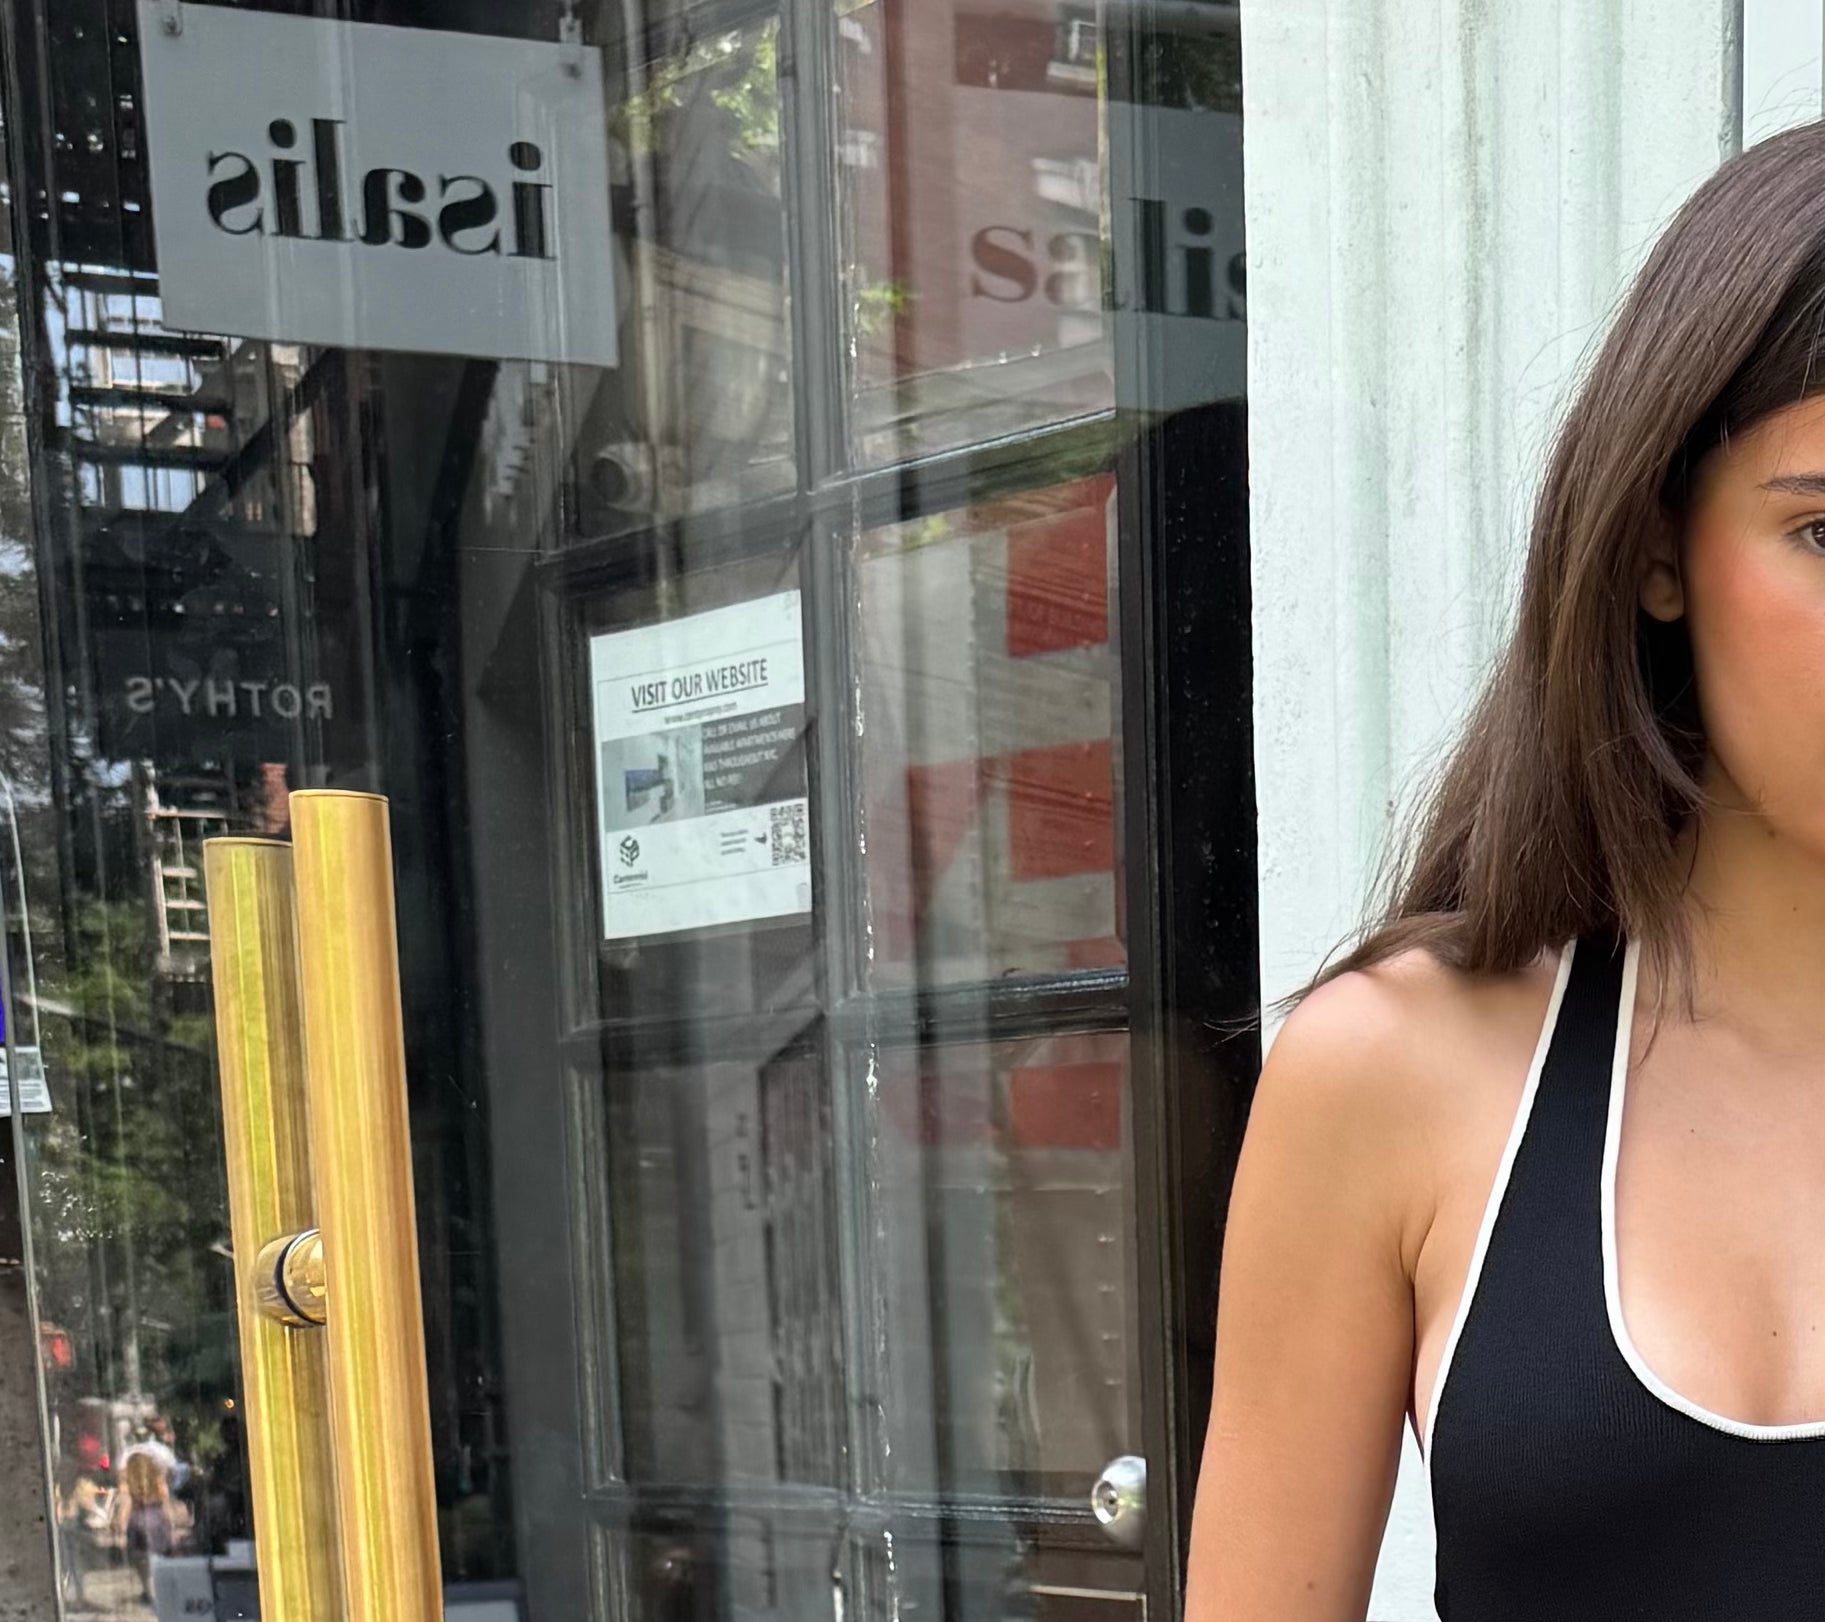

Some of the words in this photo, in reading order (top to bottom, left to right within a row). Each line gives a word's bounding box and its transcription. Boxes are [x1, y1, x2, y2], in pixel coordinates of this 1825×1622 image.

[631, 680, 668, 708] VISIT
[671, 673, 702, 700] OUR
[705, 658, 768, 692] WEBSITE
